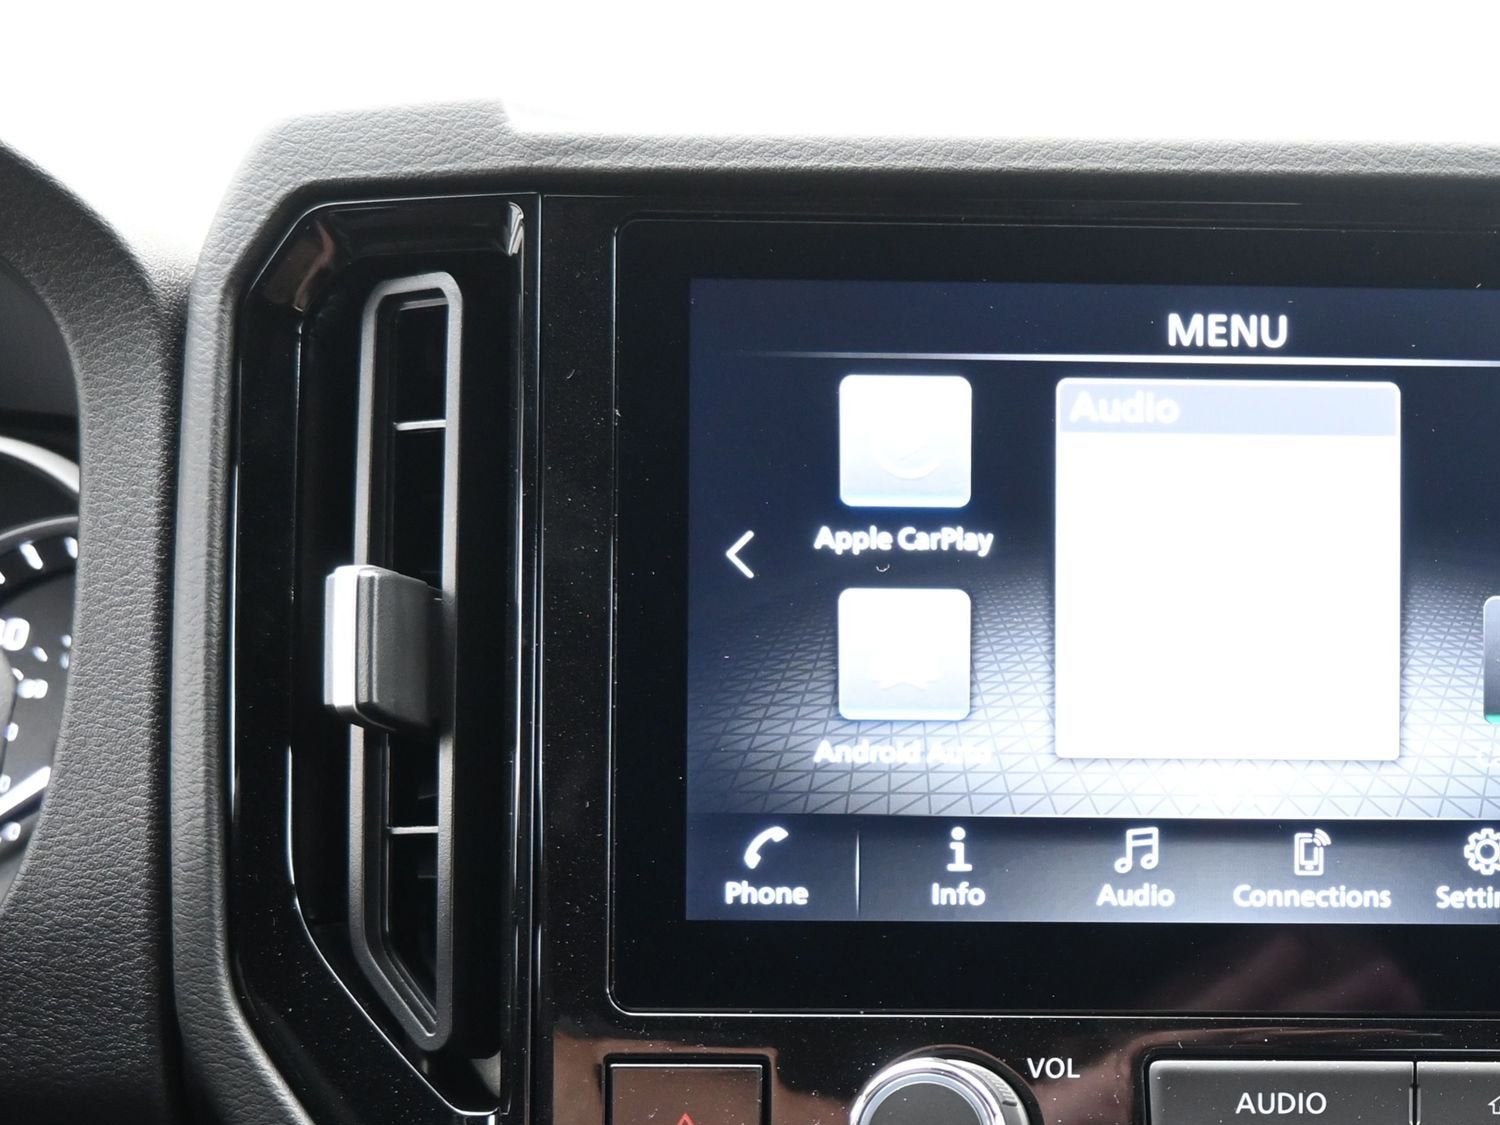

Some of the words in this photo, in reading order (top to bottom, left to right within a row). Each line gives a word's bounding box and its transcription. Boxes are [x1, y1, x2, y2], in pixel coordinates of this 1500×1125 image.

[1167, 312, 1288, 349] MENU
[1069, 390, 1180, 424] Audio
[813, 524, 894, 556] Apple
[896, 525, 995, 558] CarPlay
[813, 739, 921, 763] Android
[724, 879, 810, 906] Phone
[931, 881, 986, 907] Info
[1095, 882, 1176, 908] Audio
[1232, 883, 1392, 909] Connections
[1026, 1057, 1081, 1080] VOL
[1235, 1091, 1327, 1115] AUDIO
